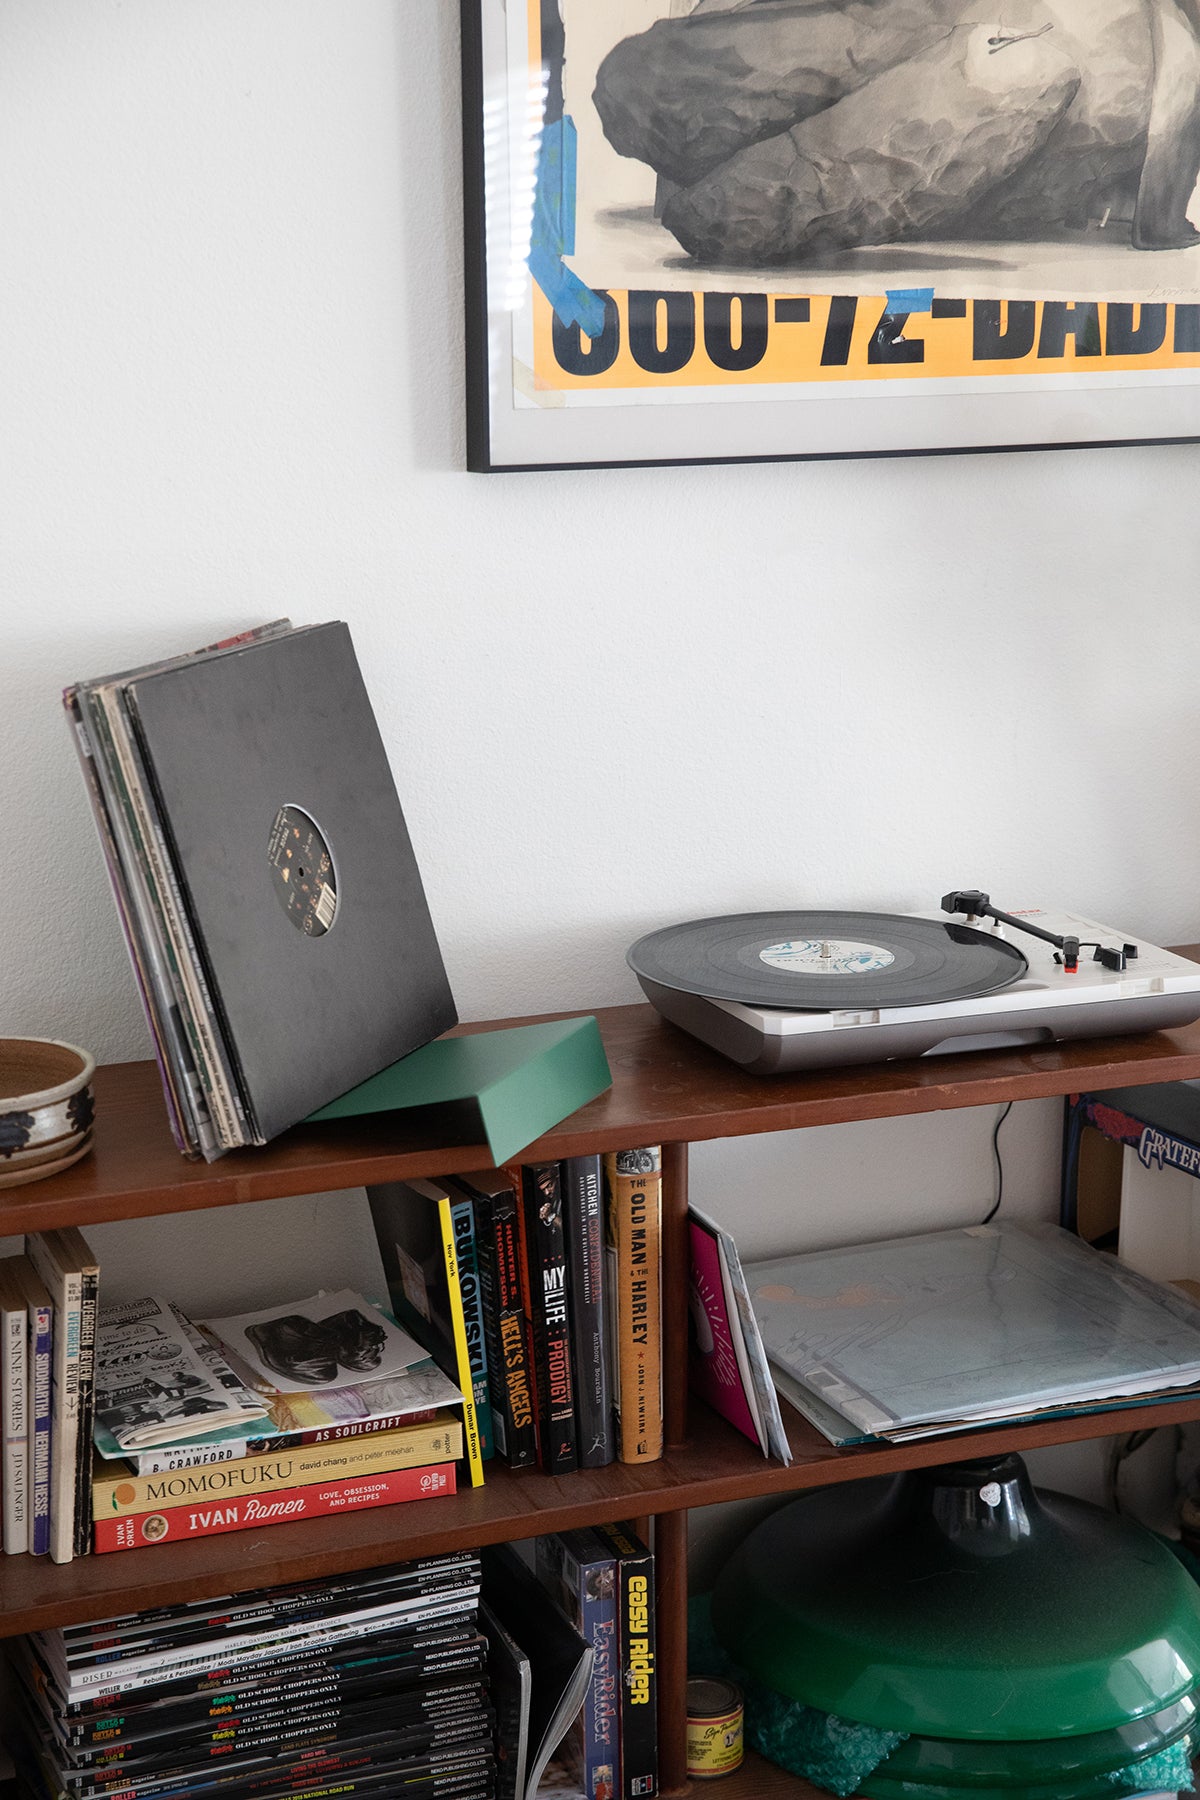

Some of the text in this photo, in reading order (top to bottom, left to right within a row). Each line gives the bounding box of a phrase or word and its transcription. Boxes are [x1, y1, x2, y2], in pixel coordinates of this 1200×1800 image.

[1139, 1127, 1200, 1170] GRATEF
[630, 1178, 647, 1188] THE
[630, 1193, 646, 1224] OLD
[505, 1224, 517, 1283] HUNTER
[587, 1174, 603, 1305] KITCHEN CONFIDENTIAL
[631, 1229, 647, 1265] MAN
[448, 1260, 456, 1278] York
[496, 1222, 509, 1307] THOMPSON
[454, 1214, 487, 1377] BUKOWSKI
[543, 1265, 567, 1326] MY LIFE
[632, 1281, 648, 1345] HARLEY
[66, 1311, 80, 1394] EVERGREEN REVIEW
[80, 1300, 96, 1381] EVERGREEN REVIEW
[10, 1340, 23, 1432] NINE STORIES
[500, 1315, 533, 1429] HELL'S ANGELS
[548, 1340, 567, 1404] PRODIGY
[316, 1416, 401, 1442] AS SOULCRAFT
[466, 1404, 474, 1432] Dumar
[34, 1353, 49, 1518] SIDDHARTHA HERMANN HESSE
[146, 1446, 415, 1501] MOMOFUKU david chang and peter meehan
[153, 1464, 164, 1473] B.
[169, 1450, 233, 1470] CRAWFORD
[320, 1483, 390, 1501] LOVE, OBSESSION,
[329, 1493, 380, 1508] AND RECIPES
[190, 1499, 306, 1531] IVAN Ramen
[117, 1524, 125, 1545] IVAN
[127, 1519, 135, 1547] ORKIN
[250, 1608, 277, 1617] SCHOOL
[278, 1600, 314, 1612] CHOPPERS
[314, 1595, 335, 1603] ONLY
[281, 1628, 298, 1636] ROAD
[99, 1685, 121, 1696] WELLER
[143, 1674, 168, 1685] Rebuild
[176, 1665, 211, 1678] Personalize
[218, 1659, 235, 1667] Mods
[236, 1652, 263, 1664] Mayday
[264, 1647, 284, 1656] Japan
[304, 1636, 328, 1647] Scooter
[328, 1628, 360, 1641] Gathering
[249, 1659, 276, 1669] SCHOOL
[278, 1652, 314, 1663] CHOPPERS
[315, 1647, 334, 1655] ONLY
[223, 1660, 328, 1686] OLD SCHOOL CHOPPERS ONLY
[238, 1673, 342, 1700] OLD SCHOOL CHOPPERS ONLY
[252, 1697, 280, 1707] SCHOOL
[280, 1690, 319, 1701] CHOPPERS
[319, 1684, 339, 1693] ONLY
[259, 1709, 286, 1720] SCHOOL
[287, 1701, 324, 1713] CHOPPERS
[324, 1696, 343, 1704] ONLY
[252, 1735, 280, 1745] SCHOOL
[280, 1727, 319, 1739] CHOPPERS
[319, 1722, 339, 1730] ONLY
[254, 1721, 282, 1732] SCHOOL
[283, 1714, 321, 1726] CHOPPERS
[322, 1709, 342, 1717] ONLY
[304, 1790, 328, 1799] NATIONAL
